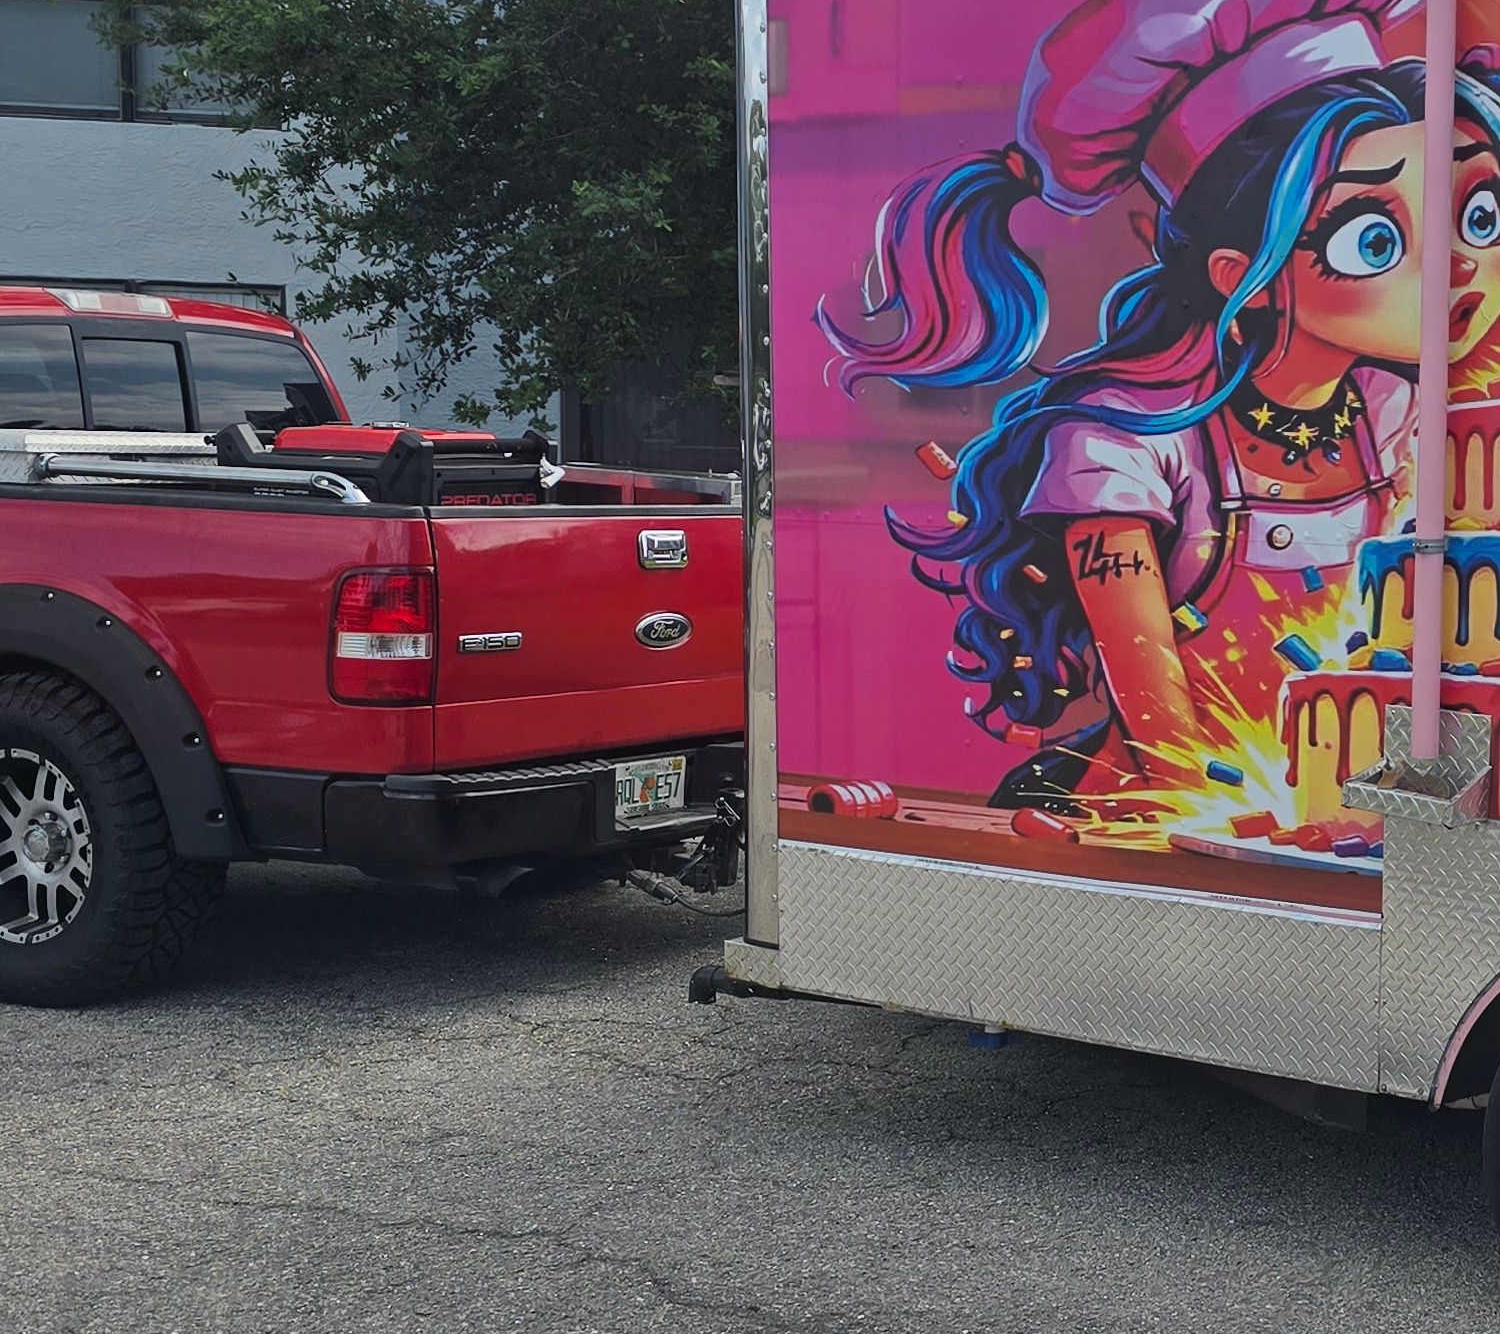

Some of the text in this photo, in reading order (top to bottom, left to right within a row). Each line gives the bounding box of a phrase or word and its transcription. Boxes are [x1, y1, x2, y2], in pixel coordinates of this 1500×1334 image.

[440, 493, 537, 506] PREDATOR
[650, 620, 682, 640] Ford
[655, 771, 682, 801] E57
